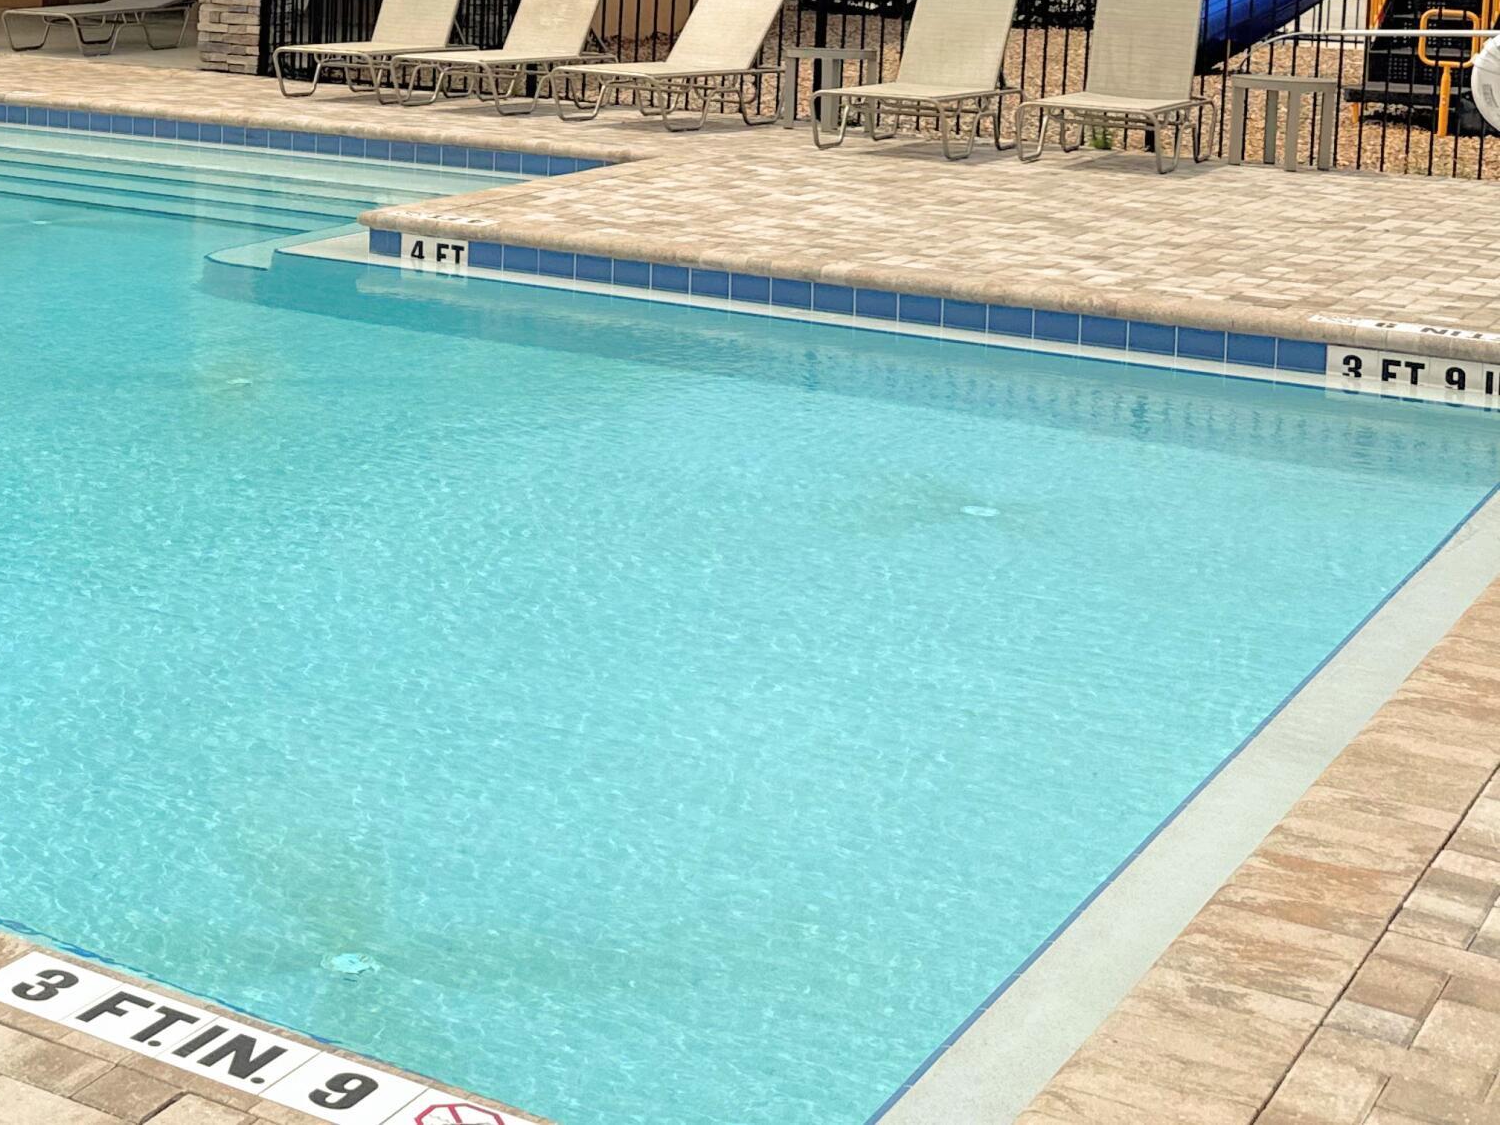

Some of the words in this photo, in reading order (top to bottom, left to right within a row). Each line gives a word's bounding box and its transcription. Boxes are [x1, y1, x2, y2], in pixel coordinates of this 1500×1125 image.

[410, 240, 425, 260] 4
[436, 242, 465, 265] FT
[1342, 354, 1363, 378] 3
[1381, 358, 1426, 386] FT
[1444, 366, 1467, 391] 9
[1485, 370, 1500, 396] I
[11, 969, 79, 1002] 3
[308, 1072, 379, 1110] 9
